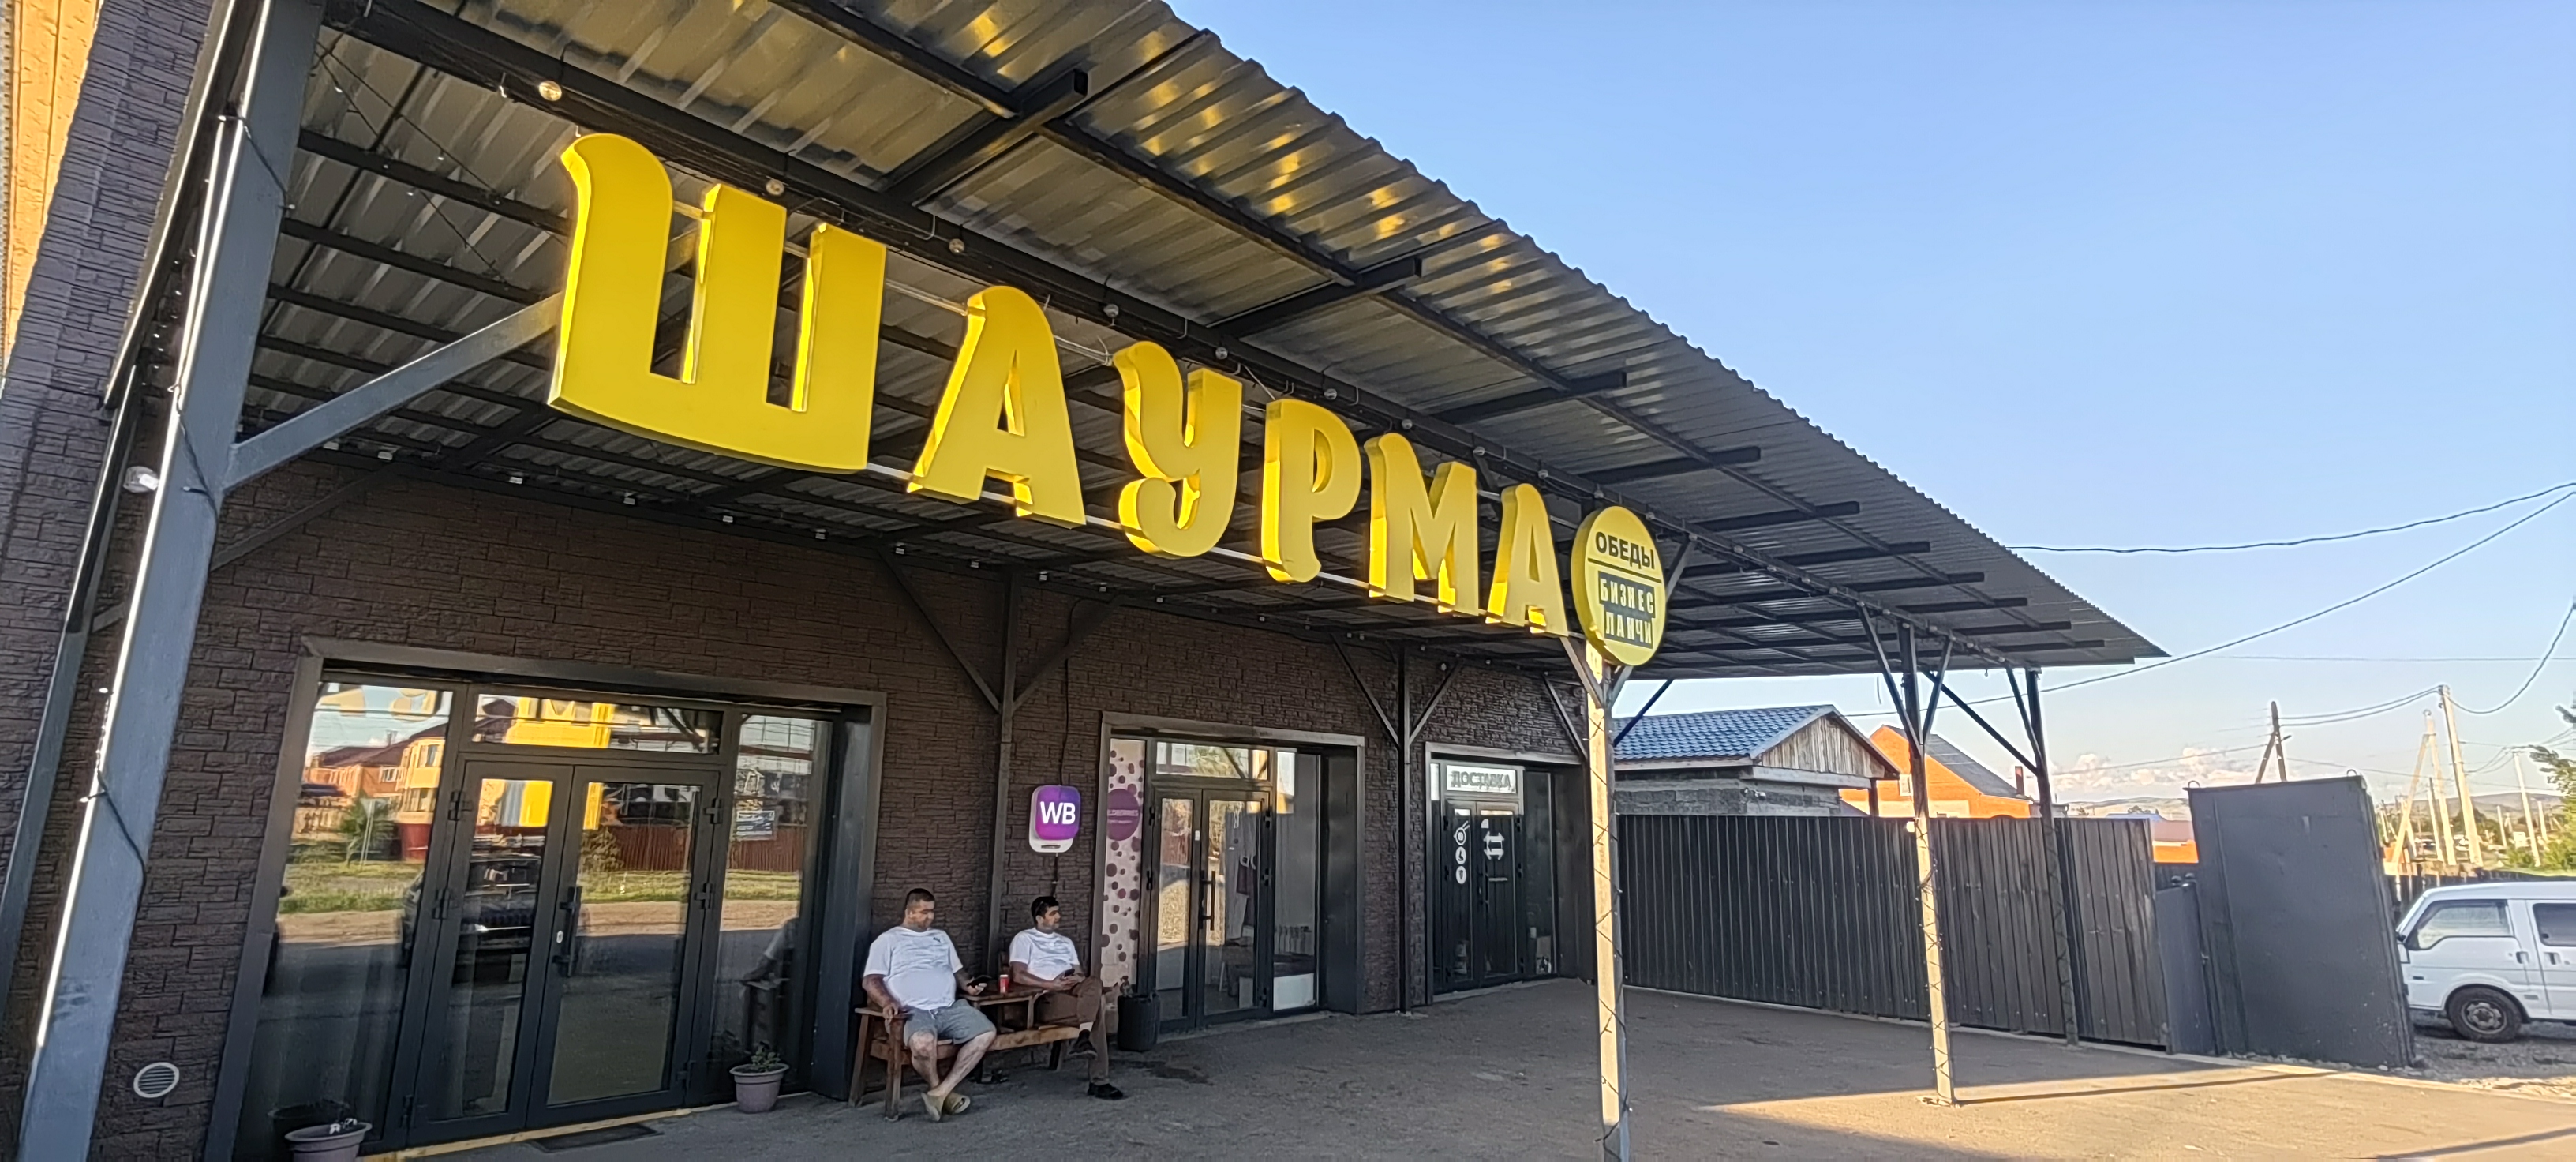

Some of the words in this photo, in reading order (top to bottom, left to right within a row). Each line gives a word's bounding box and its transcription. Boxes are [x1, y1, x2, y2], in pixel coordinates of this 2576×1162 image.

[548, 133, 1569, 636] ШАУРМА
[1595, 531, 1655, 569] ОБЕДЫ
[1600, 578, 1654, 614] БИЗНЕС
[1605, 611, 1652, 644] ЛАНЧИ
[1450, 770, 1511, 790] ДОСТАВКА
[1040, 801, 1076, 824] WB
